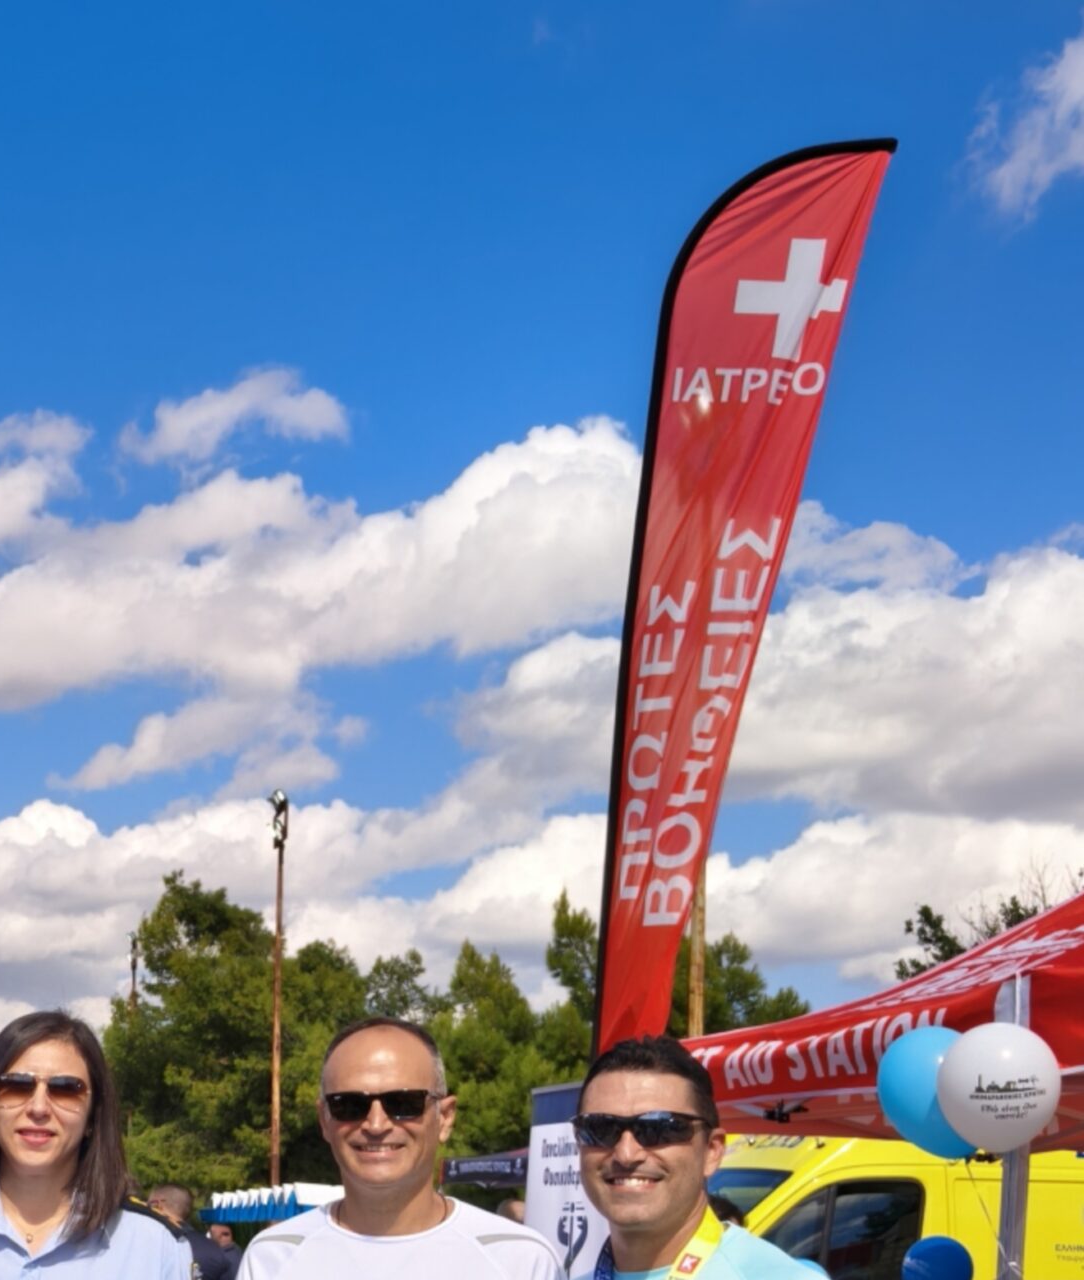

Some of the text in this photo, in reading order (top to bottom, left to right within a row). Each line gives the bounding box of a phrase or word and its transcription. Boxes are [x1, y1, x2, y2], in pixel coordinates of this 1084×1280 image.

[619, 579, 695, 900] ΠΡΩΤΕΣ
[643, 517, 782, 927] ΒΟΗΘΕΙΕΣ
[724, 1039, 782, 1090] AID
